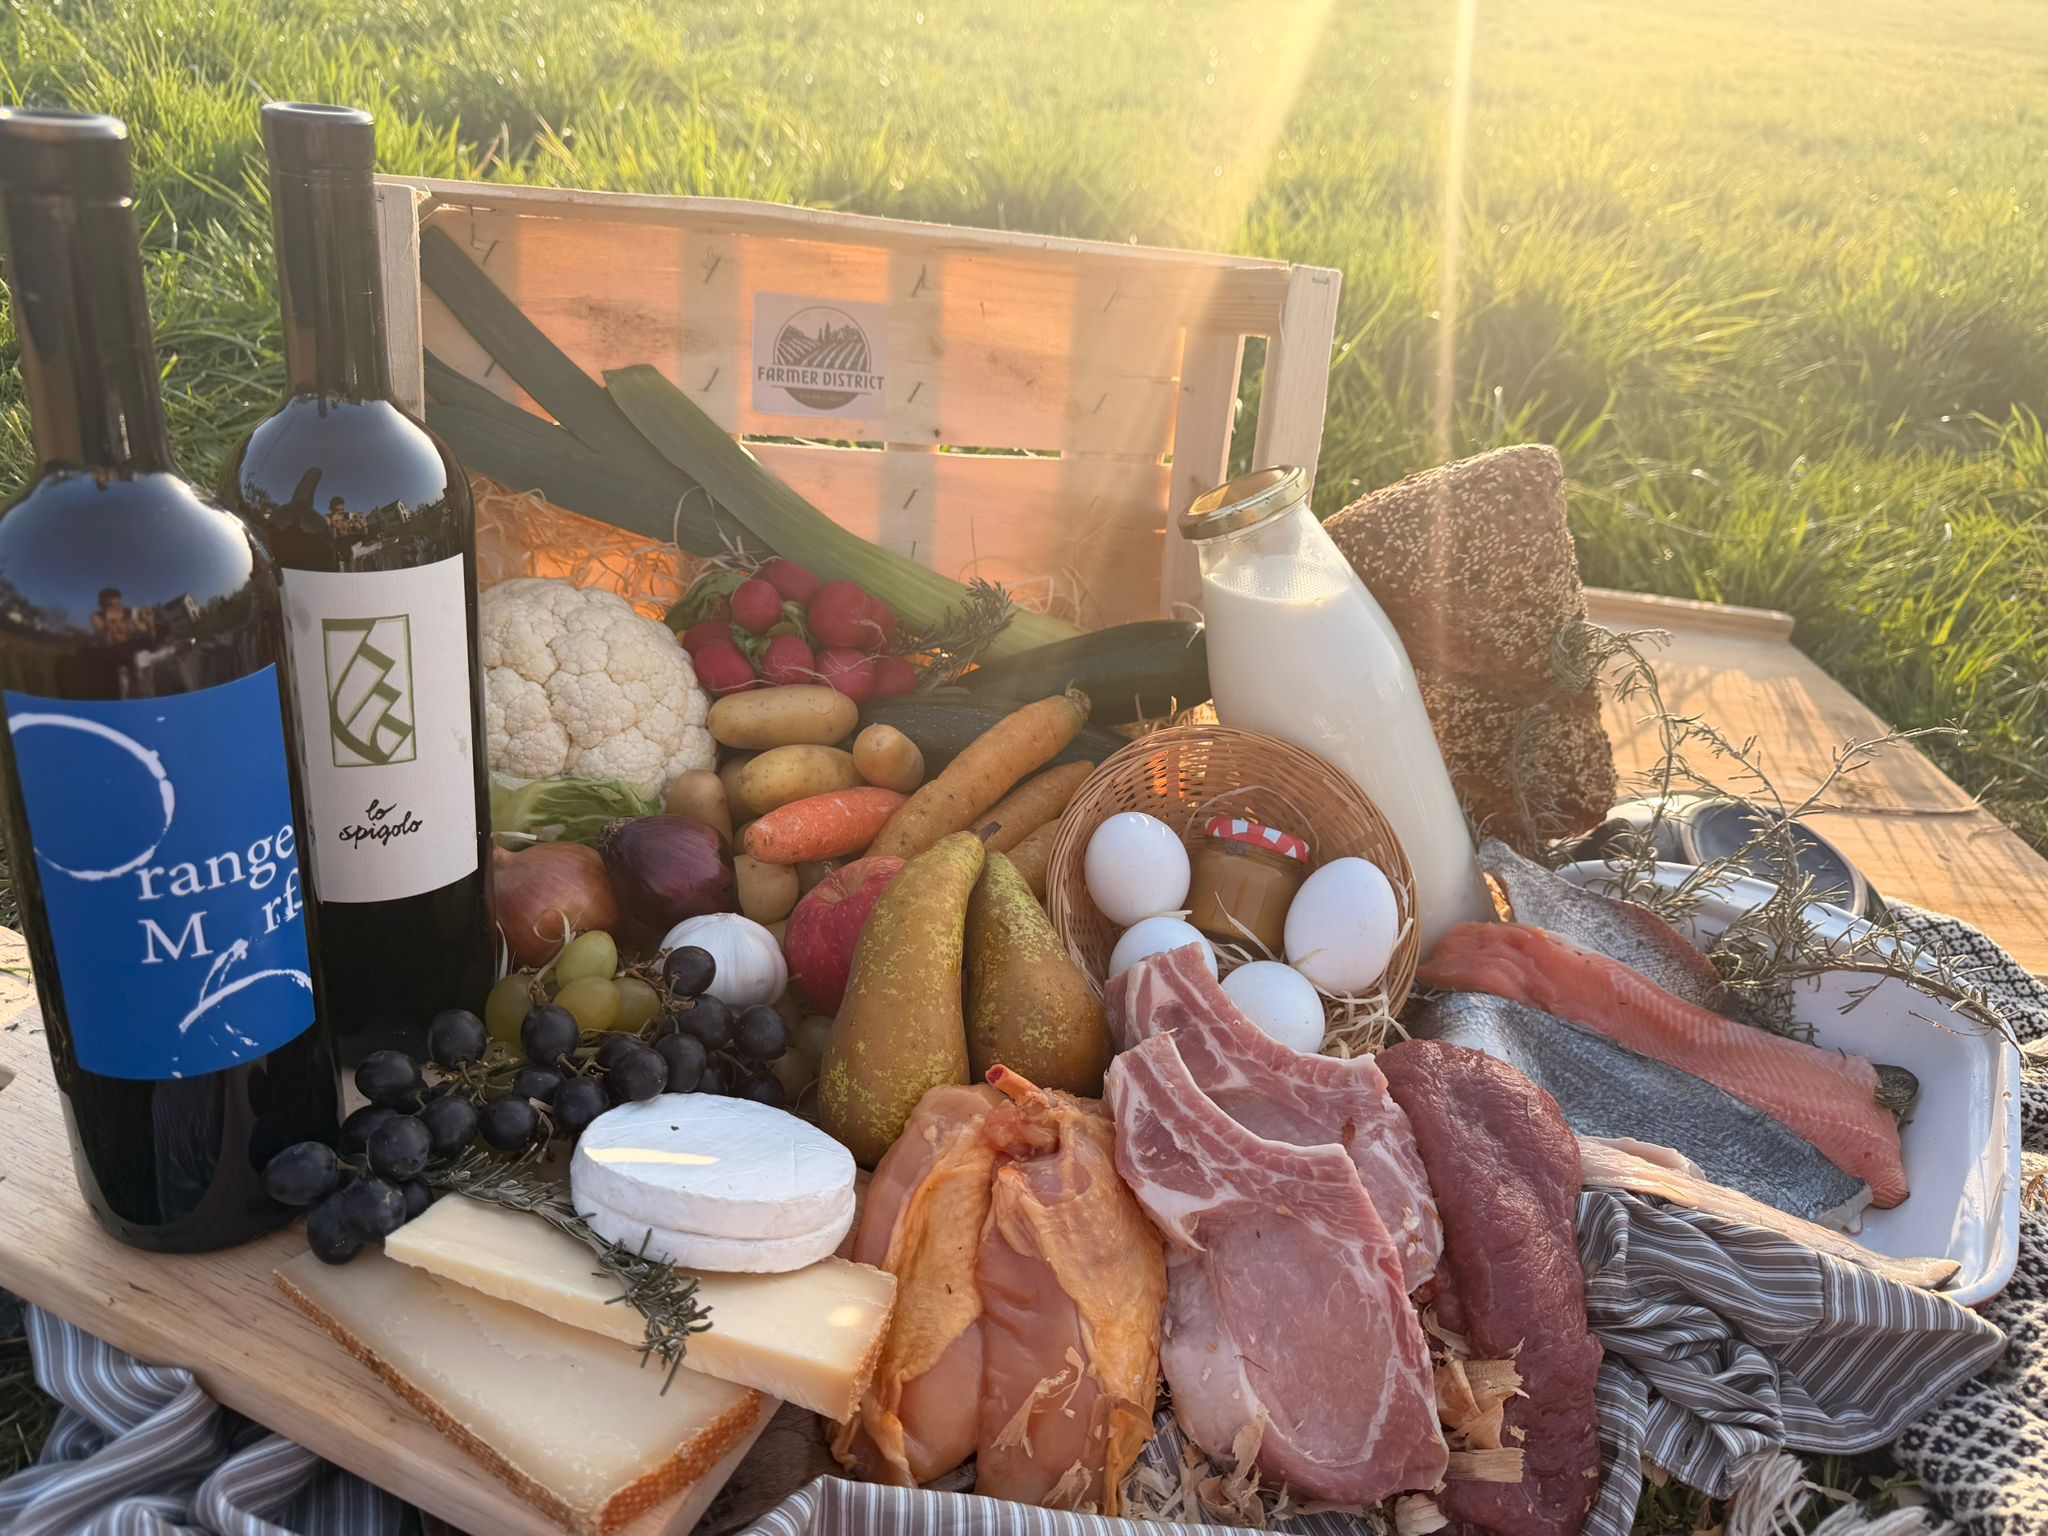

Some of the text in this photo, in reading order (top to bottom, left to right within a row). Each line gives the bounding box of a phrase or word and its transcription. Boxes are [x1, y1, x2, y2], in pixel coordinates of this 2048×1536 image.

[757, 366, 885, 391] FARMER DISTRICT
[365, 798, 397, 821] lo
[338, 810, 423, 850] spigolo
